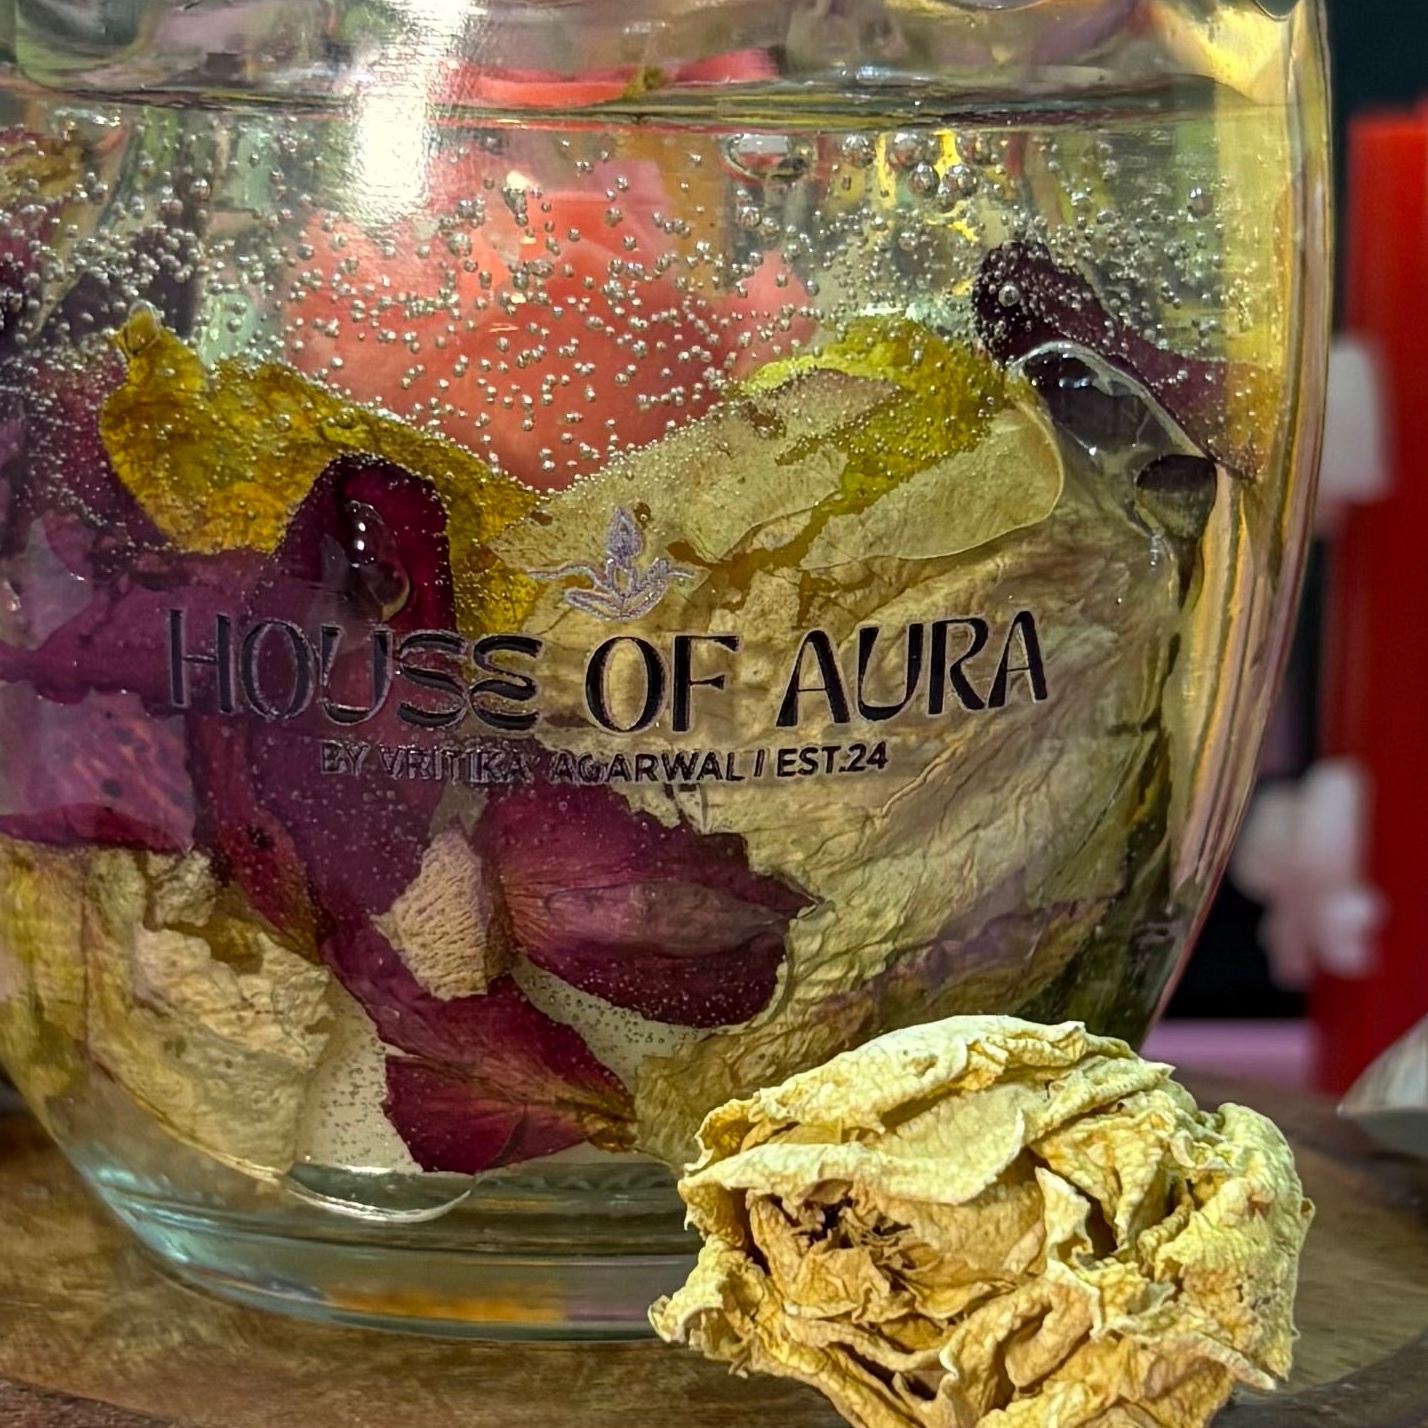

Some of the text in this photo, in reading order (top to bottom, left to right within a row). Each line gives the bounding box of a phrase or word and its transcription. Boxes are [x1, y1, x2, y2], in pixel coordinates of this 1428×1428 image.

[168, 608, 1049, 734] HOUSE OF AURA
[321, 738, 371, 776] BY
[379, 743, 533, 784] VRITIKA
[551, 749, 746, 785] AGARWAL
[776, 740, 889, 778] EST.24
